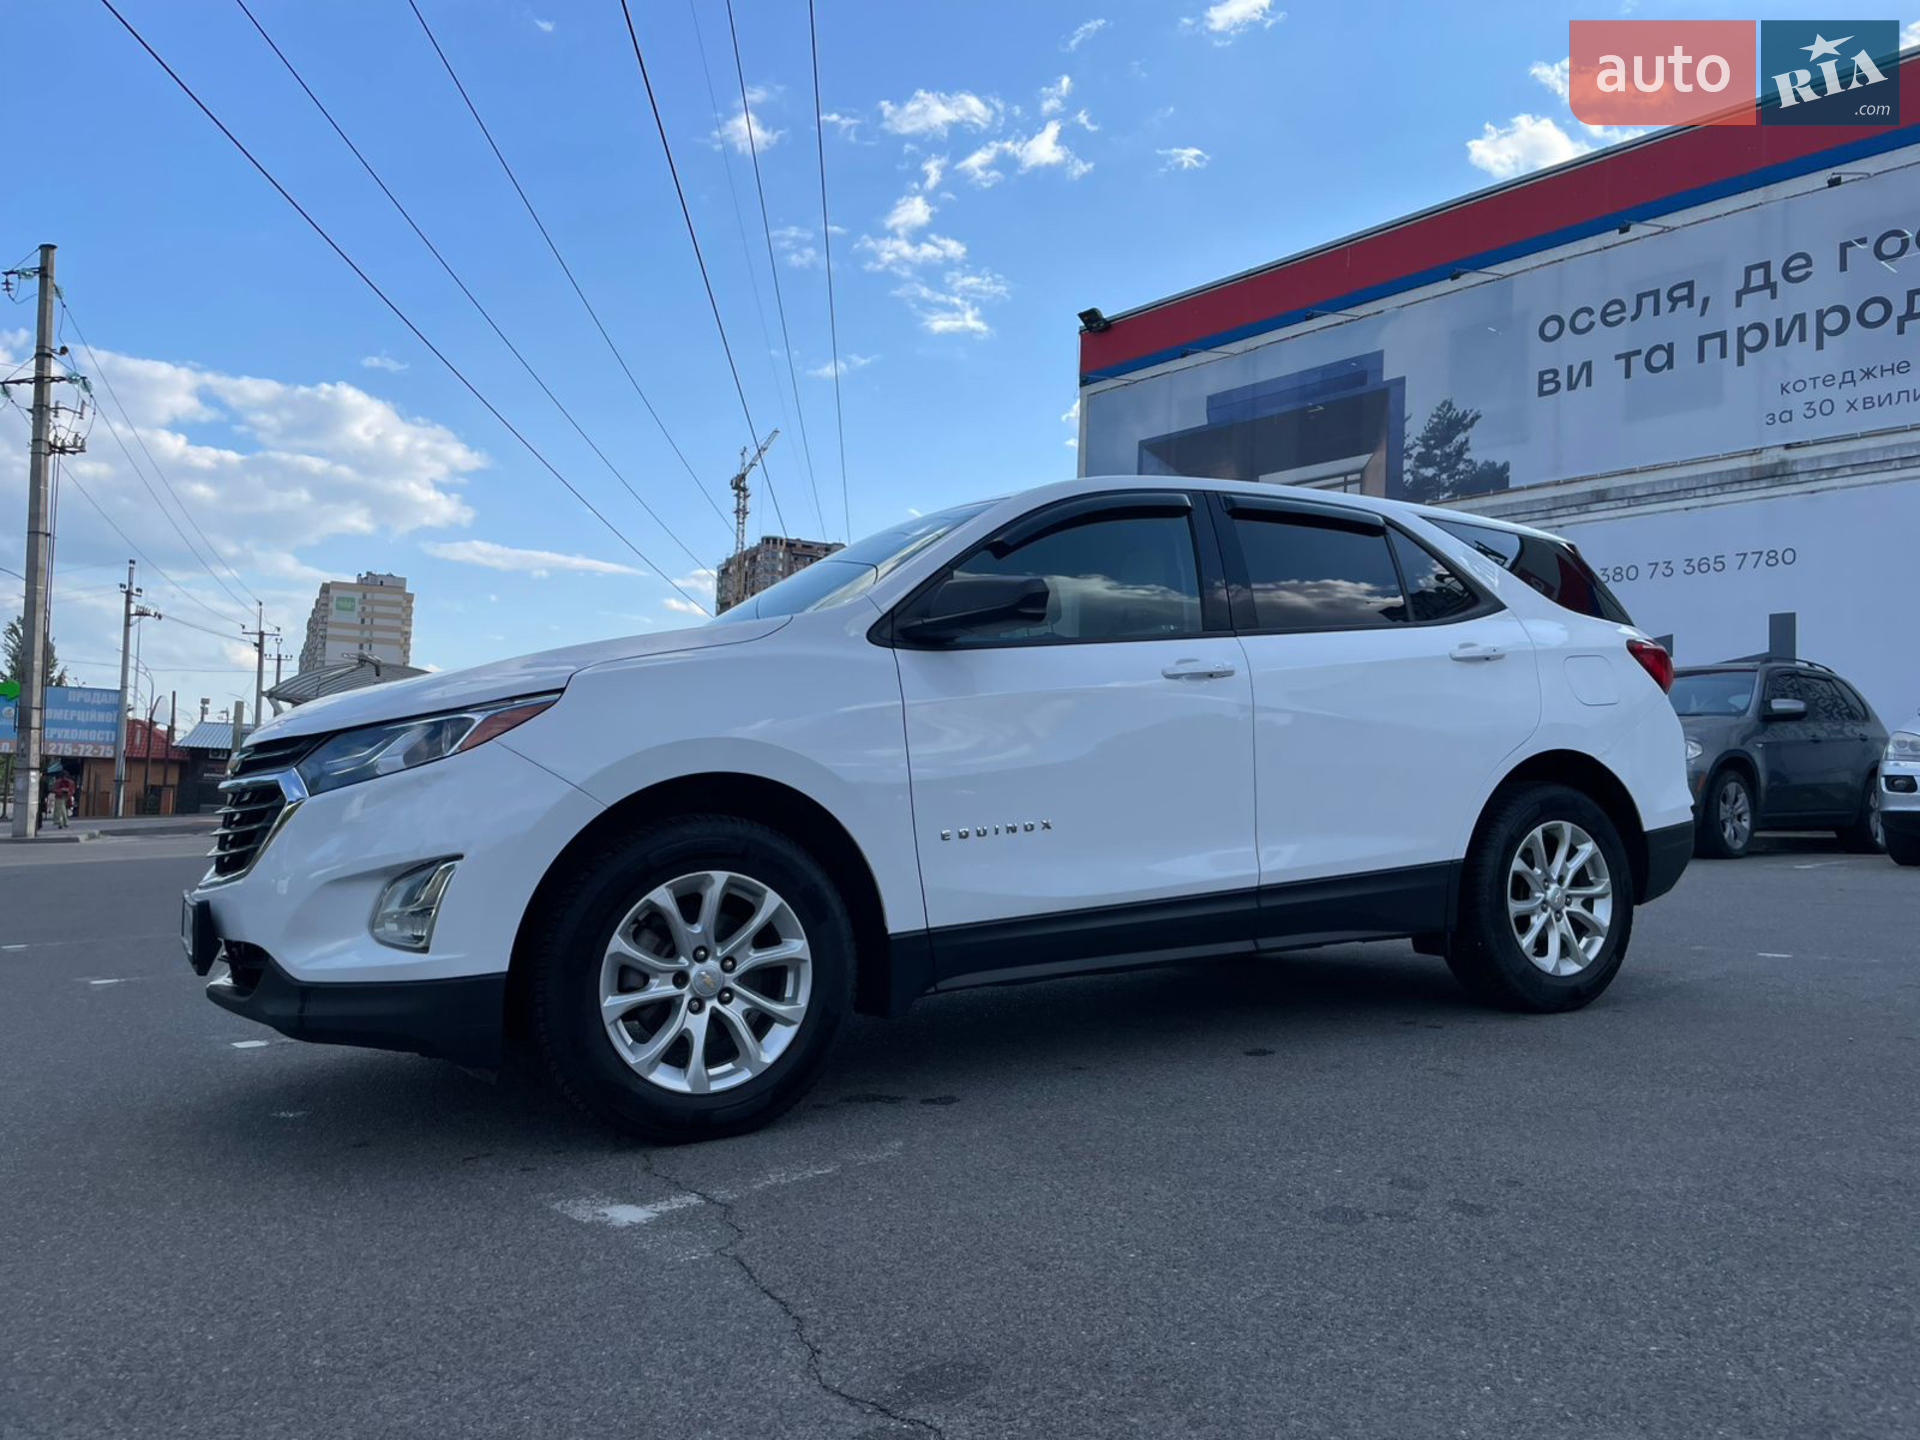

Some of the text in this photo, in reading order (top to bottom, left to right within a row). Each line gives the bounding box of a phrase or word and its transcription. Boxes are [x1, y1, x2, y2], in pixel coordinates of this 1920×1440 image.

[1538, 227, 1920, 343] оселя, де го
[1537, 360, 1593, 398] ви
[1614, 341, 1675, 379] та
[1779, 359, 1911, 396] котеджне
[1765, 409, 1793, 426] за
[1803, 398, 1835, 420] 30
[1648, 561, 1674, 579] 73
[1683, 555, 1726, 575] 365
[1736, 548, 1797, 571] 7780
[48, 743, 114, 757] 275-72-75
[940, 819, 1052, 841] EQUINOX
